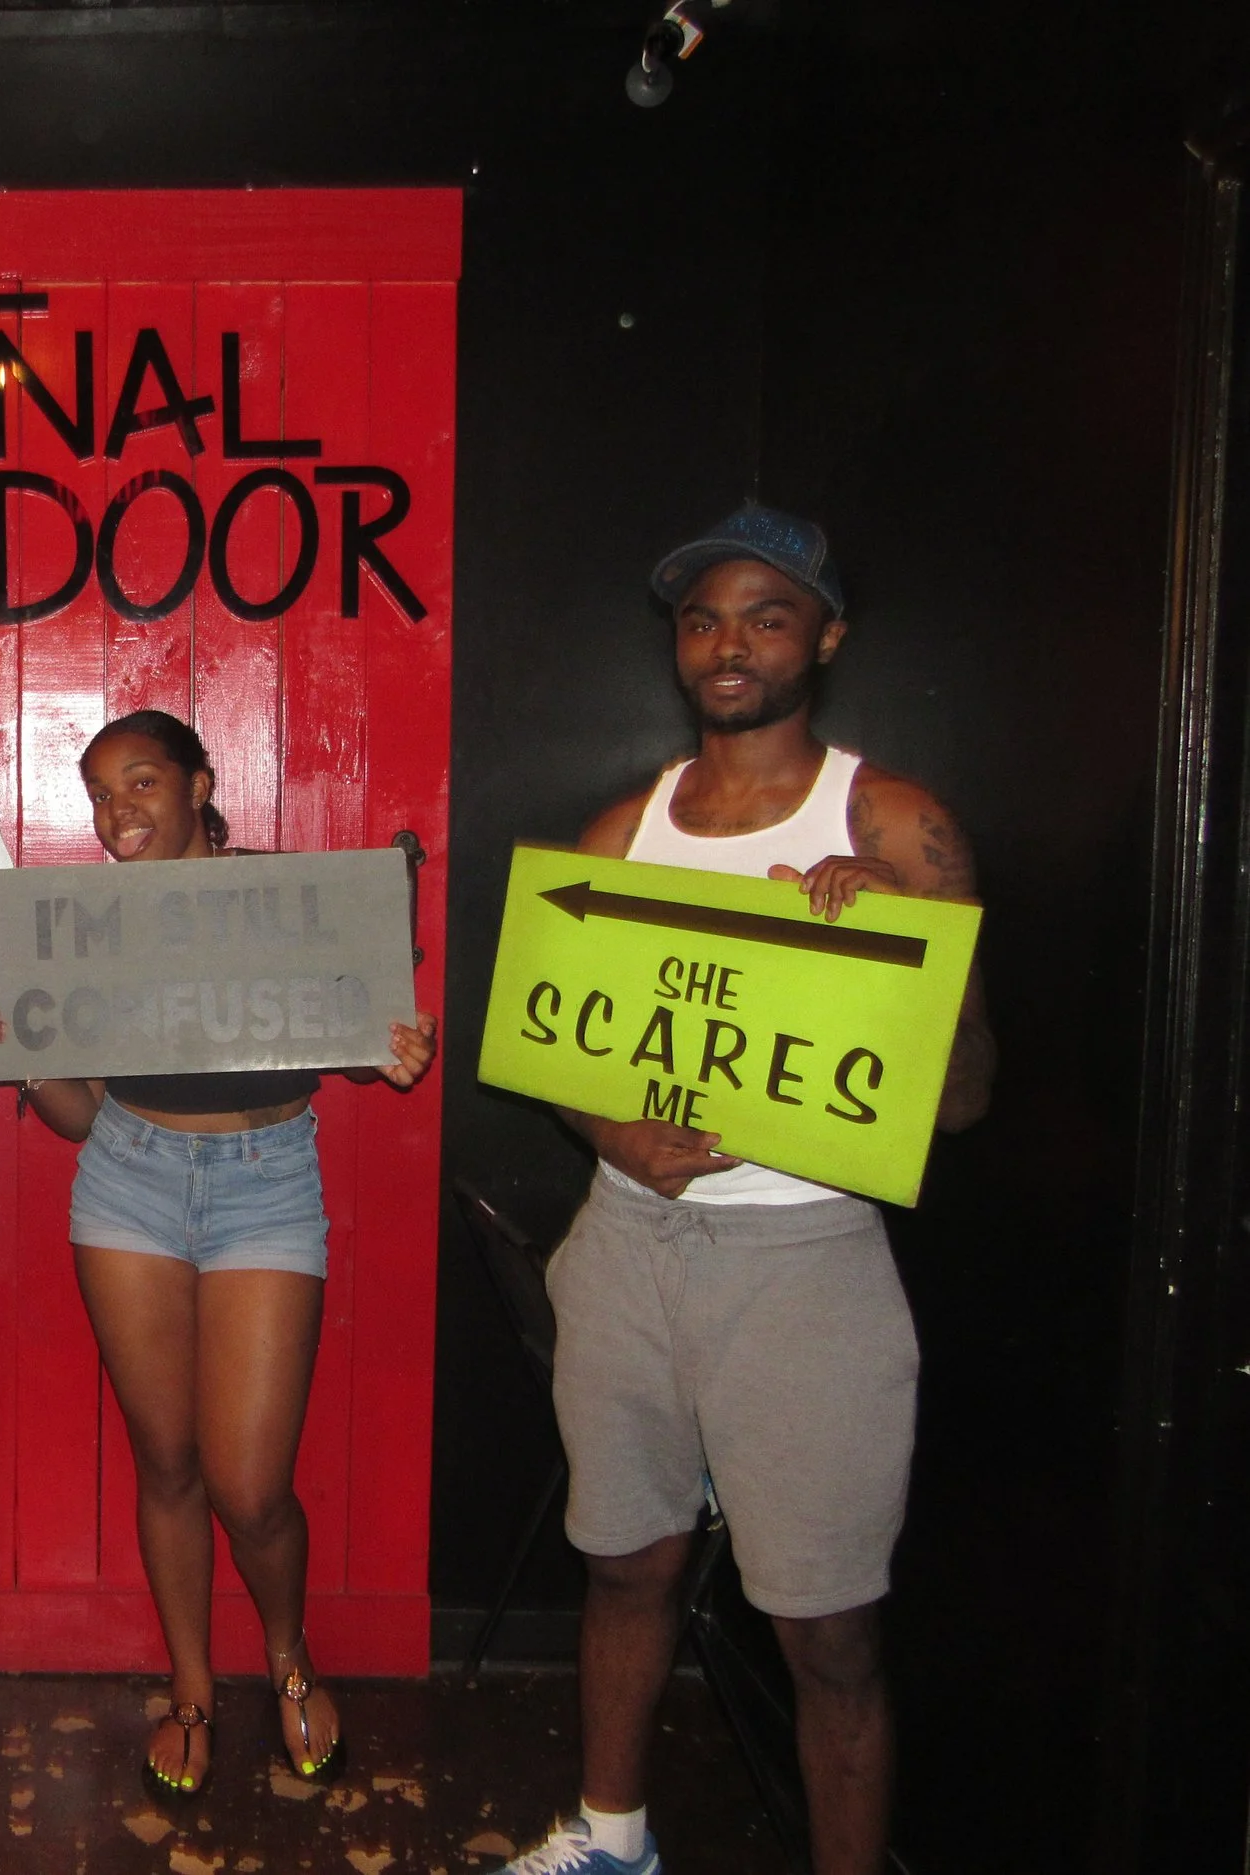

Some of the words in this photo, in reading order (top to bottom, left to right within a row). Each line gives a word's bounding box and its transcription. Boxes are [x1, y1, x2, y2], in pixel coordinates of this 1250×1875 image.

[35, 894, 122, 961] I'M
[159, 884, 338, 946] STILL
[12, 974, 370, 1052] CONFUSED
[654, 955, 744, 1011] SHE
[520, 980, 885, 1125] SCARES
[642, 1078, 710, 1130] ME
